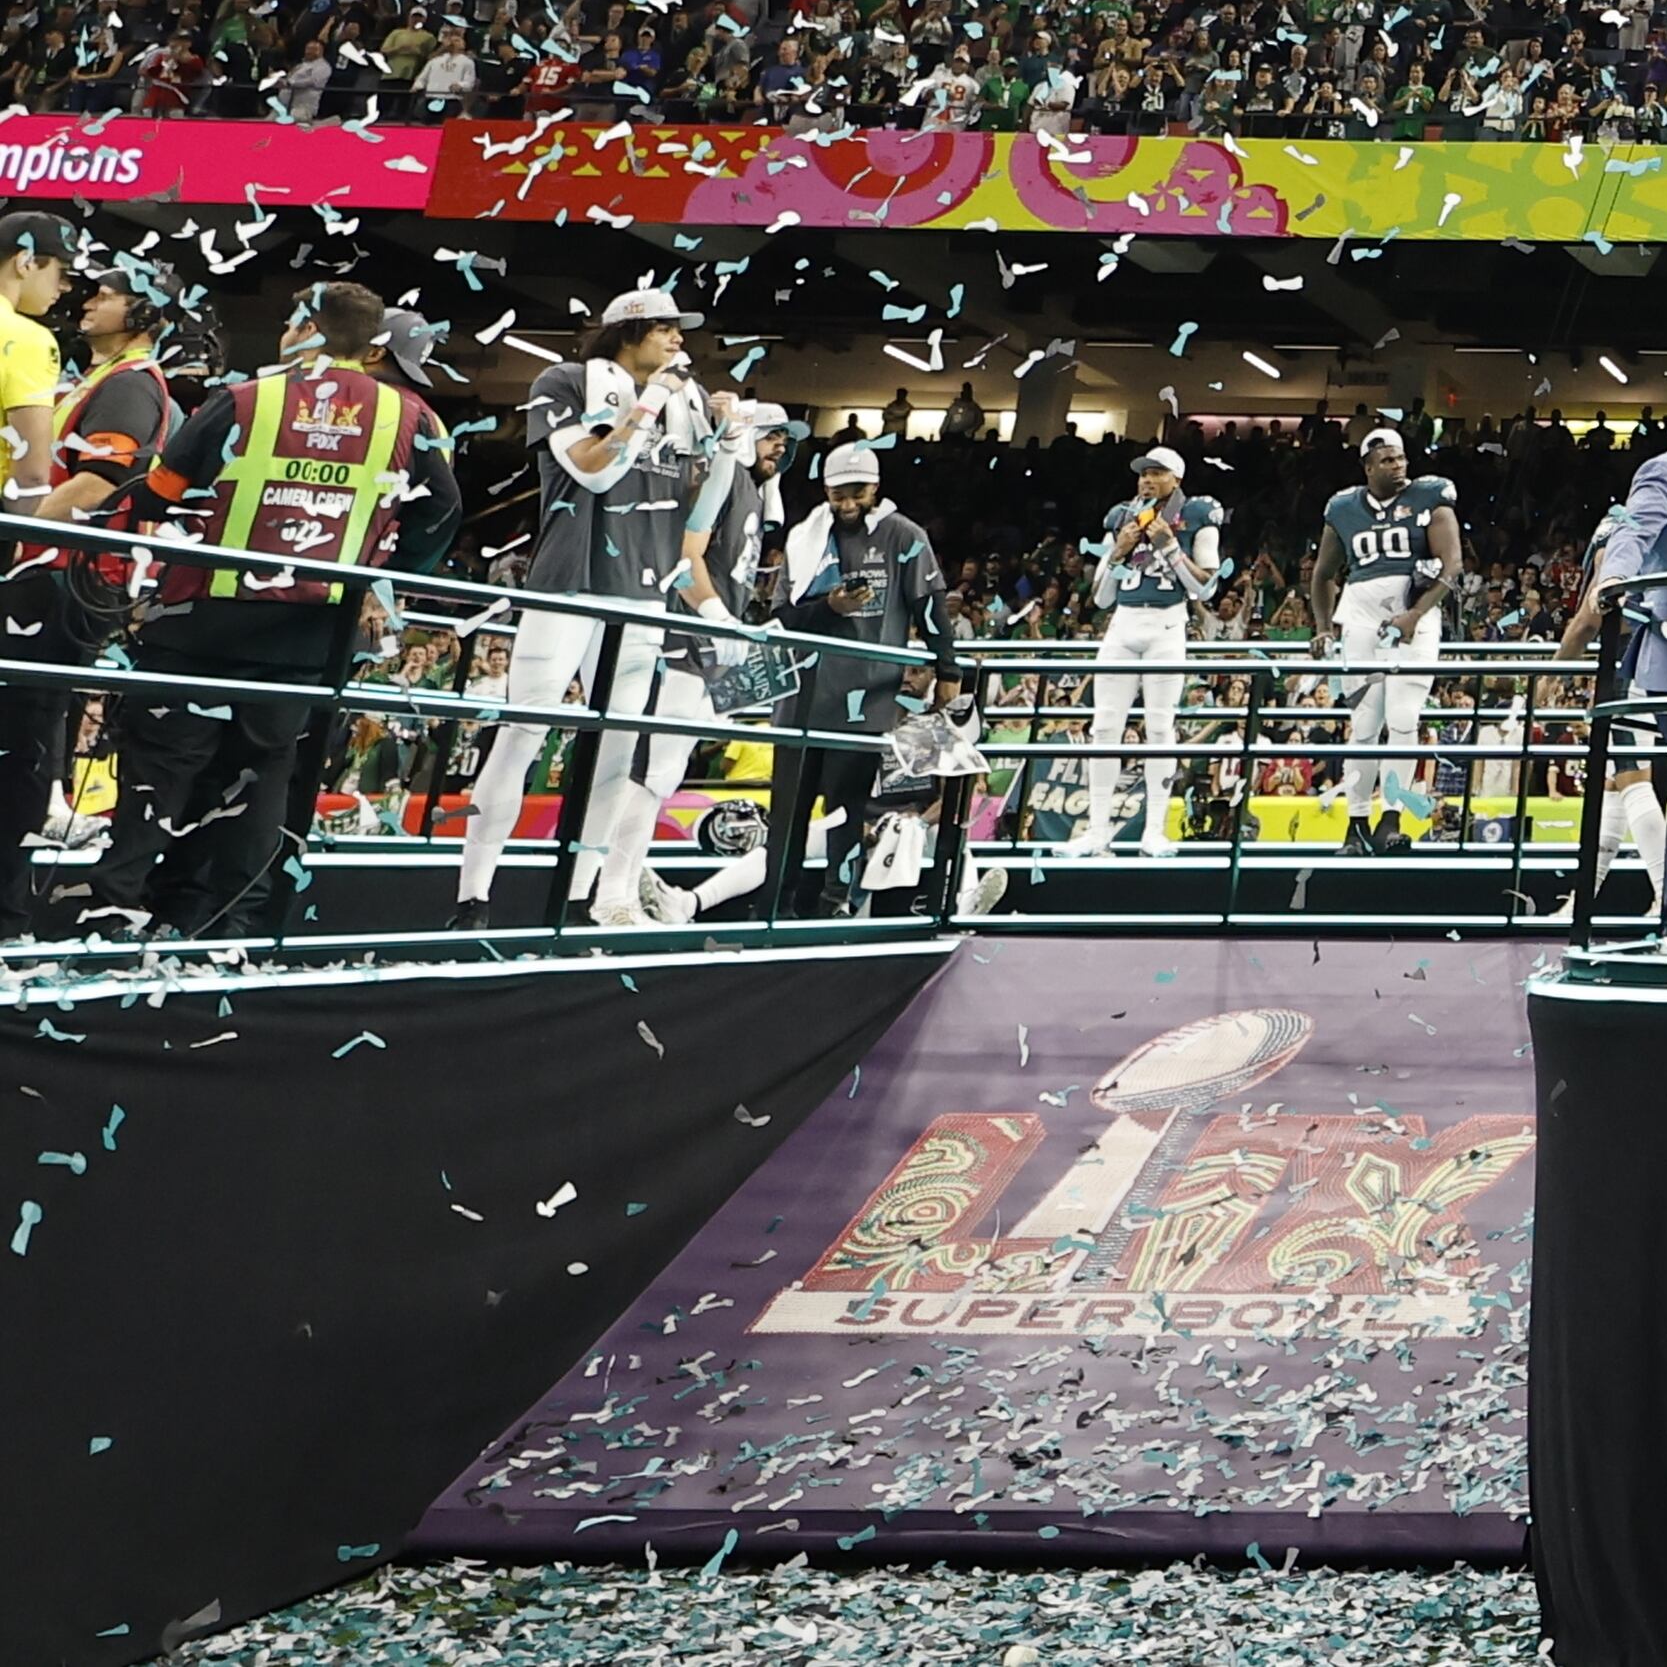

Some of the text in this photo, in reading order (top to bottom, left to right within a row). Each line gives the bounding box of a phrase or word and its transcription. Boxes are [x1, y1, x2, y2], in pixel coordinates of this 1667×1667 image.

[540, 66, 562, 84] 15
[306, 432, 342, 451] FOX
[286, 460, 350, 485] 00:00
[1352, 526, 1412, 567] 90
[1028, 781, 1145, 819] EAGES
[834, 1298, 1126, 1331] SUPER
